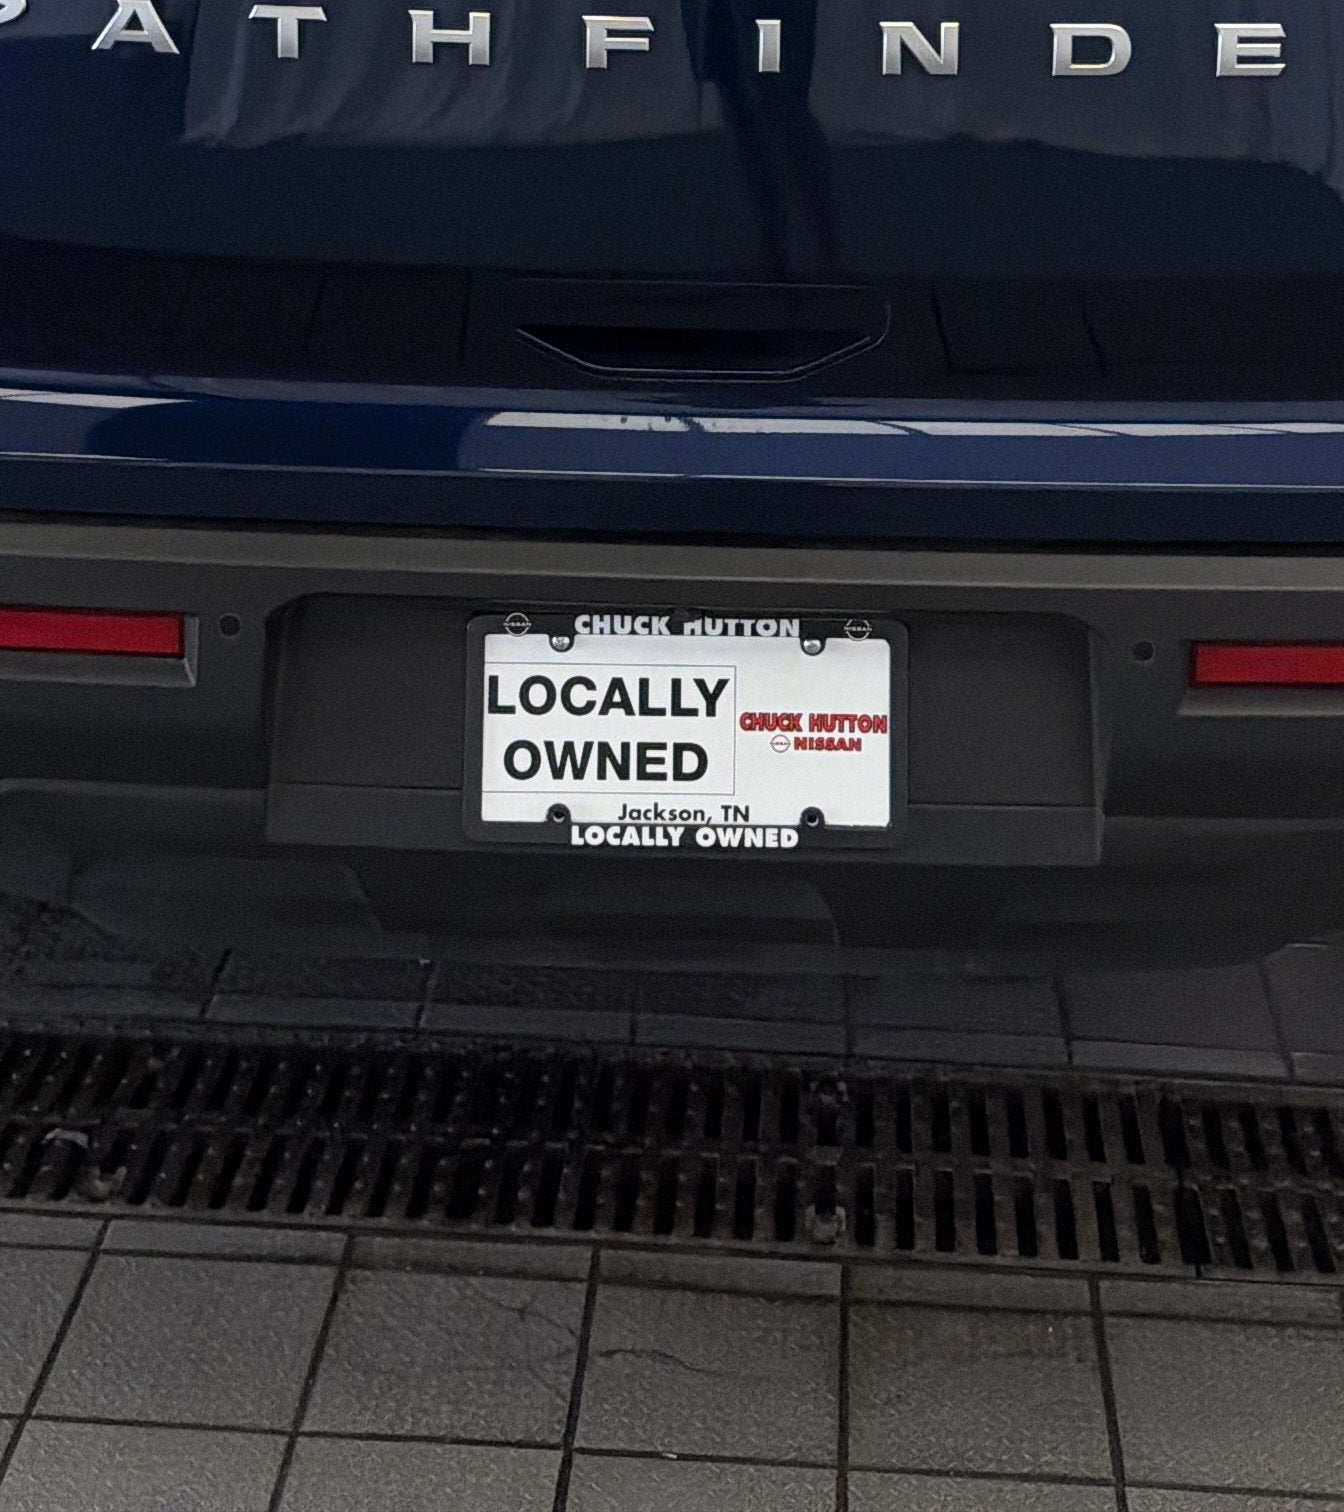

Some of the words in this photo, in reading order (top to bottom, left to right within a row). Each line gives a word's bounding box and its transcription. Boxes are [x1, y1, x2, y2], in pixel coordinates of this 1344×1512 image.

[574, 614, 671, 635] CHUCK
[683, 616, 800, 637] HUTTON
[487, 675, 730, 717] LOCALLY
[739, 712, 803, 732] CHUCK
[808, 713, 888, 734] HUTTON
[793, 736, 862, 751] NISSAN
[503, 739, 708, 782] OWNED
[617, 802, 712, 825] Jackson,
[721, 805, 750, 822] TN
[571, 825, 685, 847] LOCALLY
[695, 827, 799, 848] OWNED
